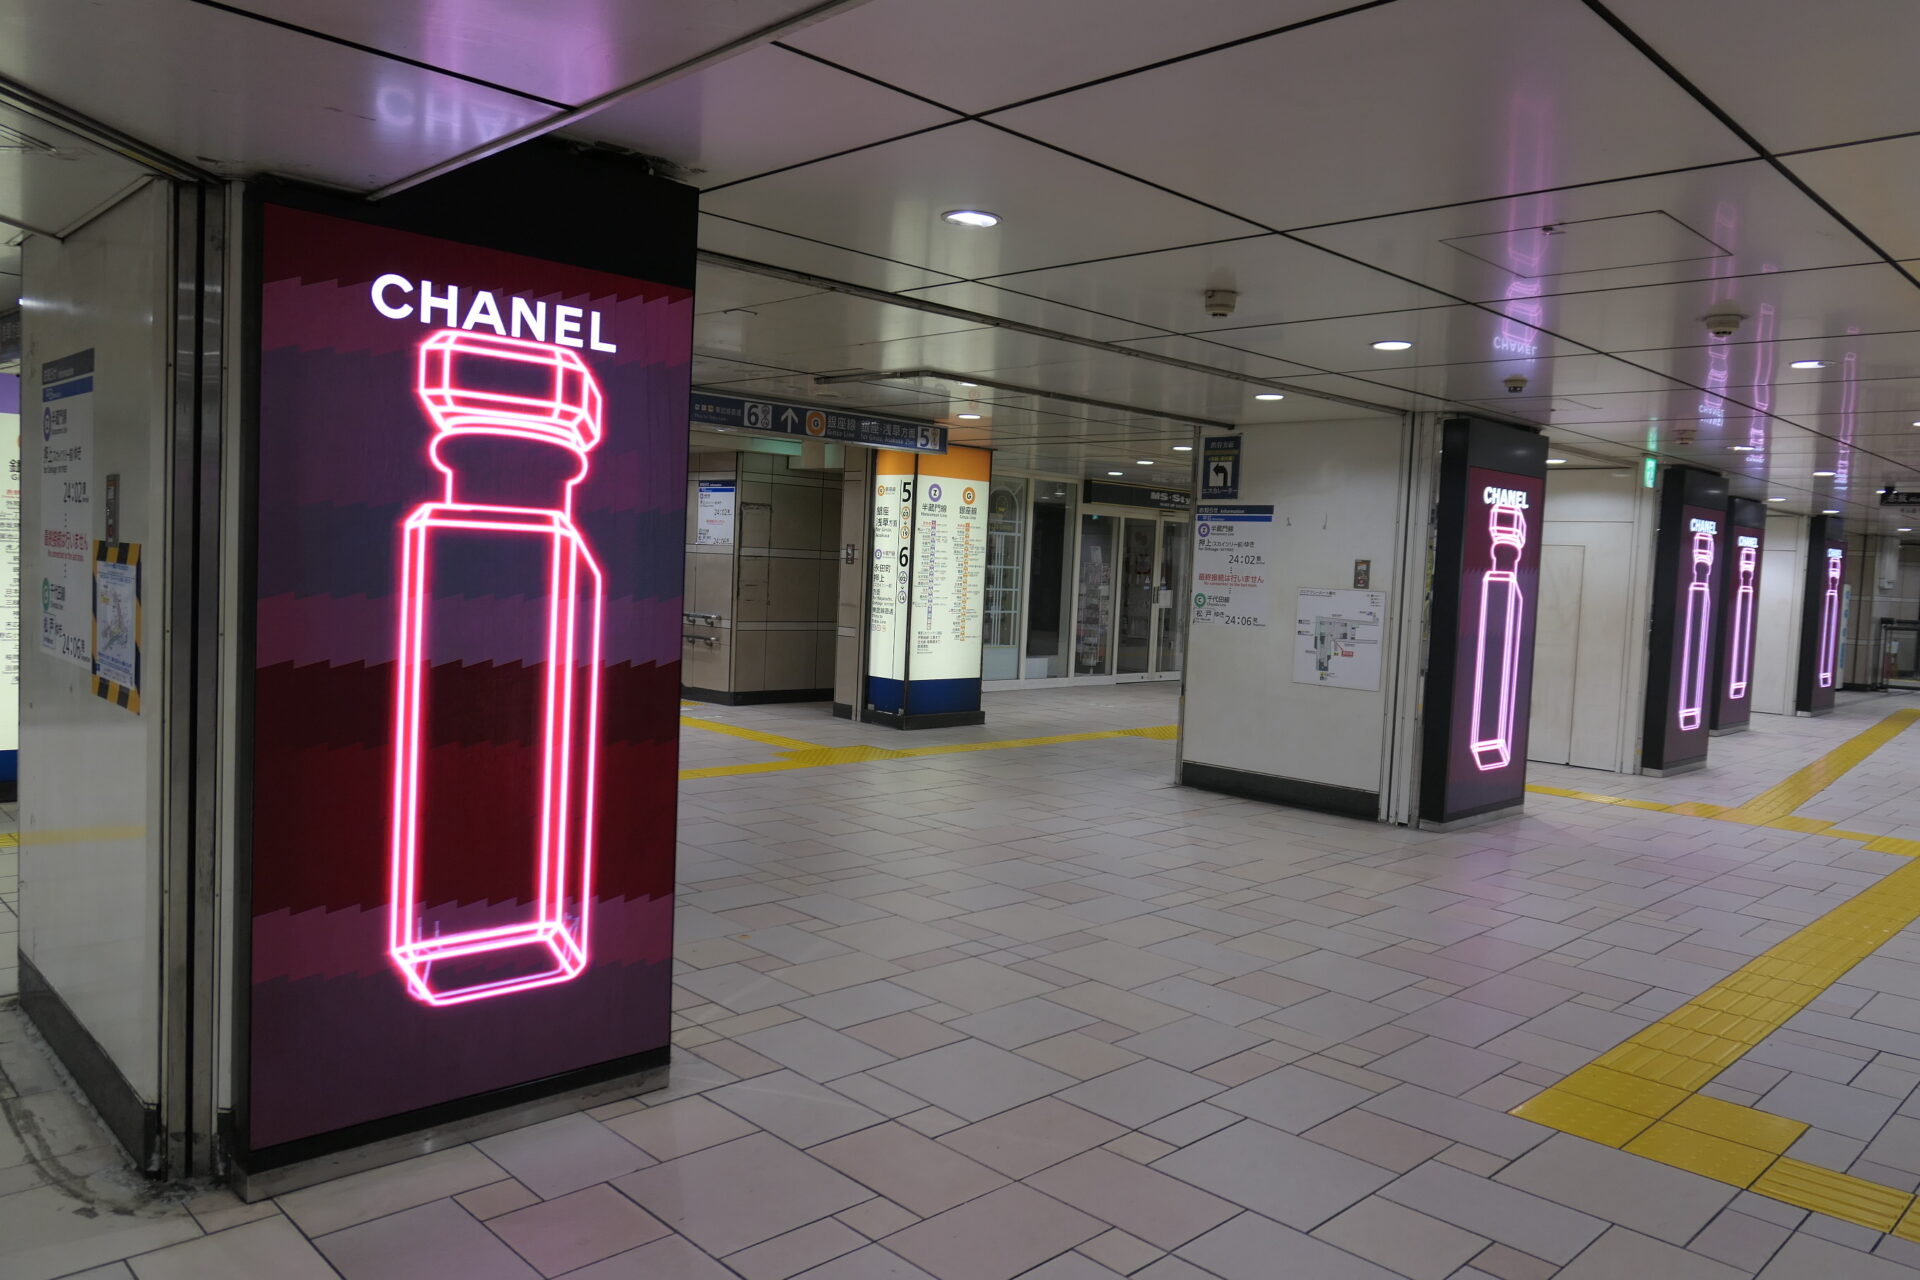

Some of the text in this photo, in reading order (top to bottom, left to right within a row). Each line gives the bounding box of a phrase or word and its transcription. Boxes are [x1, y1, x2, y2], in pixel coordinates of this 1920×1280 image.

[371, 273, 617, 354] CHANEL
[747, 404, 759, 426] 6
[827, 415, 856, 431] 銀座線
[920, 428, 930, 448] 5
[902, 481, 911, 502] 5
[1483, 486, 1529, 509] CHANEL
[922, 503, 947, 513] 半蔵門線
[1211, 525, 1234, 533] 半蔵門線
[1690, 518, 1717, 535] CHANEL
[1738, 535, 1759, 548] CHANEL
[899, 546, 909, 567] 6
[1228, 554, 1256, 565] 24:02
[1199, 573, 1265, 584] 最終接続は行いません
[1207, 595, 1230, 603] 千代田線
[1225, 615, 1252, 626] 24:06
[62, 633, 81, 659] 24:06
